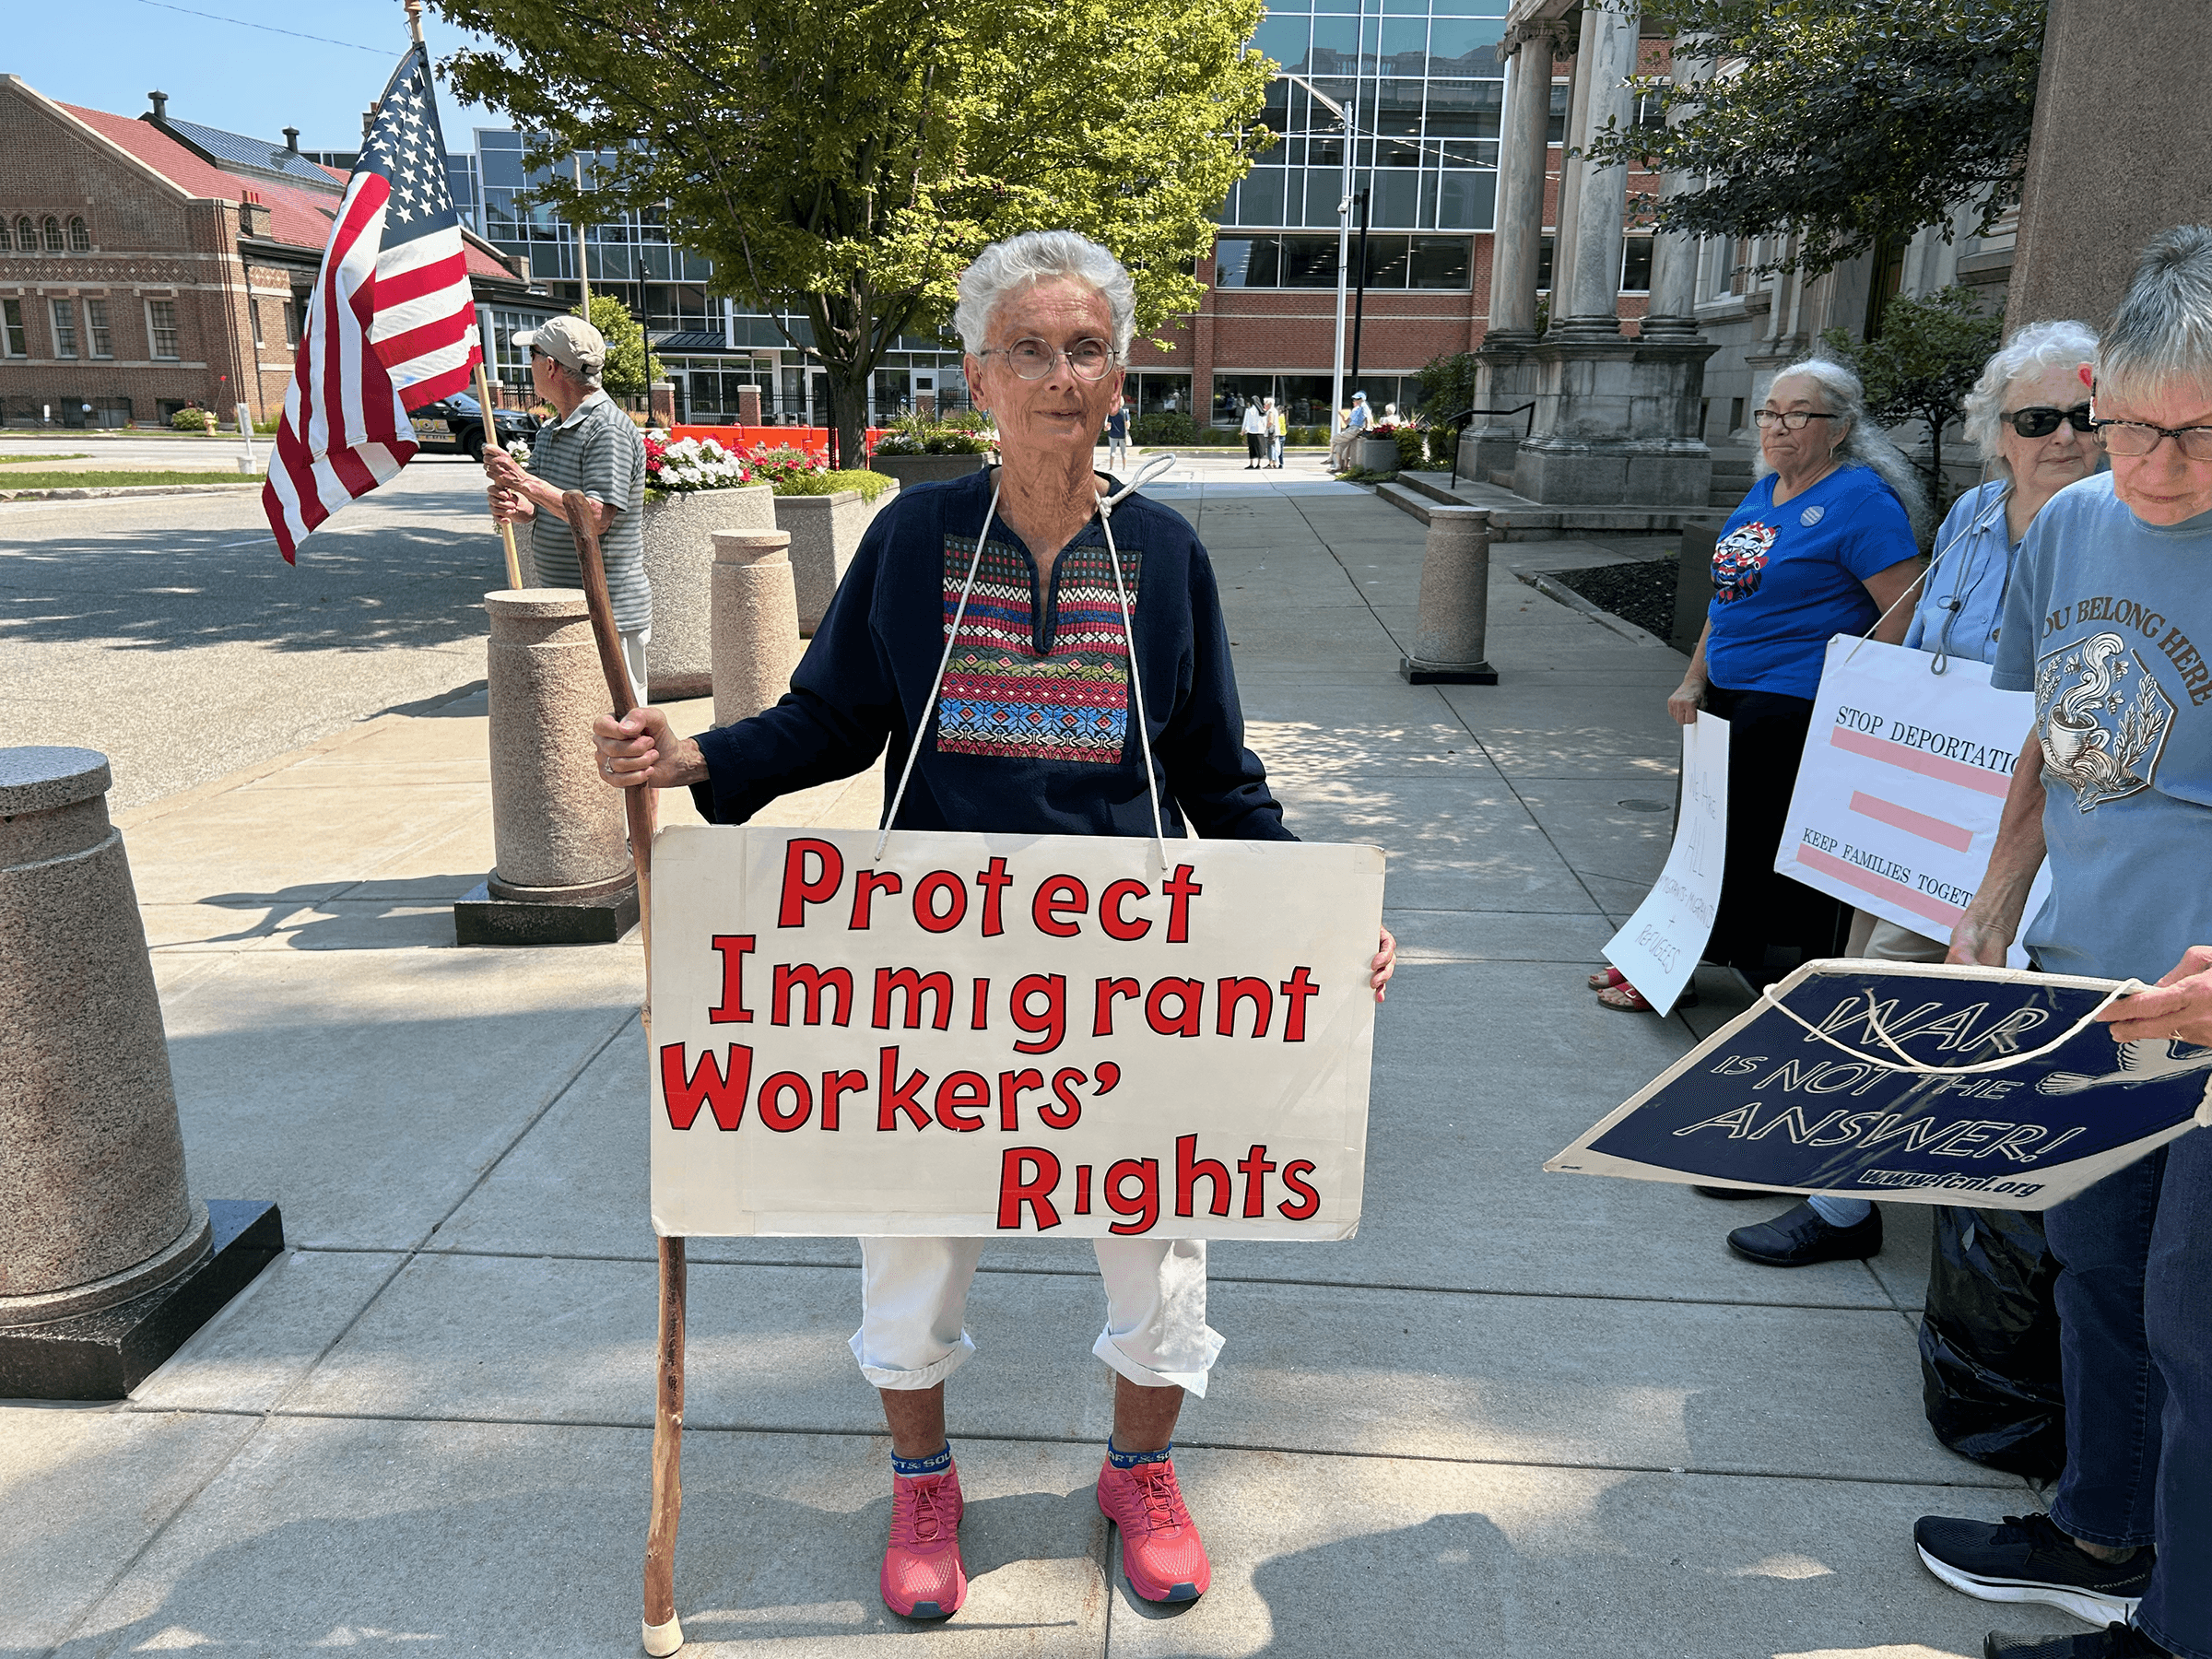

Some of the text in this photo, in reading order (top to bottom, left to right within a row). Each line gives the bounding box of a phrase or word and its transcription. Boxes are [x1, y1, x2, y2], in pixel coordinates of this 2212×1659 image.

[2077, 596, 2166, 638] BELONG
[2158, 626, 2212, 707] HERE
[1835, 705, 1883, 735] STOP
[1802, 828, 1838, 853] KEEP
[1841, 843, 1911, 884] FAMILIES
[778, 837, 1203, 944] Protect
[1634, 924, 1681, 974] REFUGEES
[708, 934, 1321, 1055] Immigrant
[1804, 997, 2049, 1053] WAR
[660, 1041, 1121, 1133] Workers'
[1711, 1055, 2024, 1100] IS NOT THE
[1673, 1102, 2087, 1162] ANSWER!
[996, 1133, 1321, 1236] Rights
[1857, 1170, 2045, 1198] www.fcnl.org
